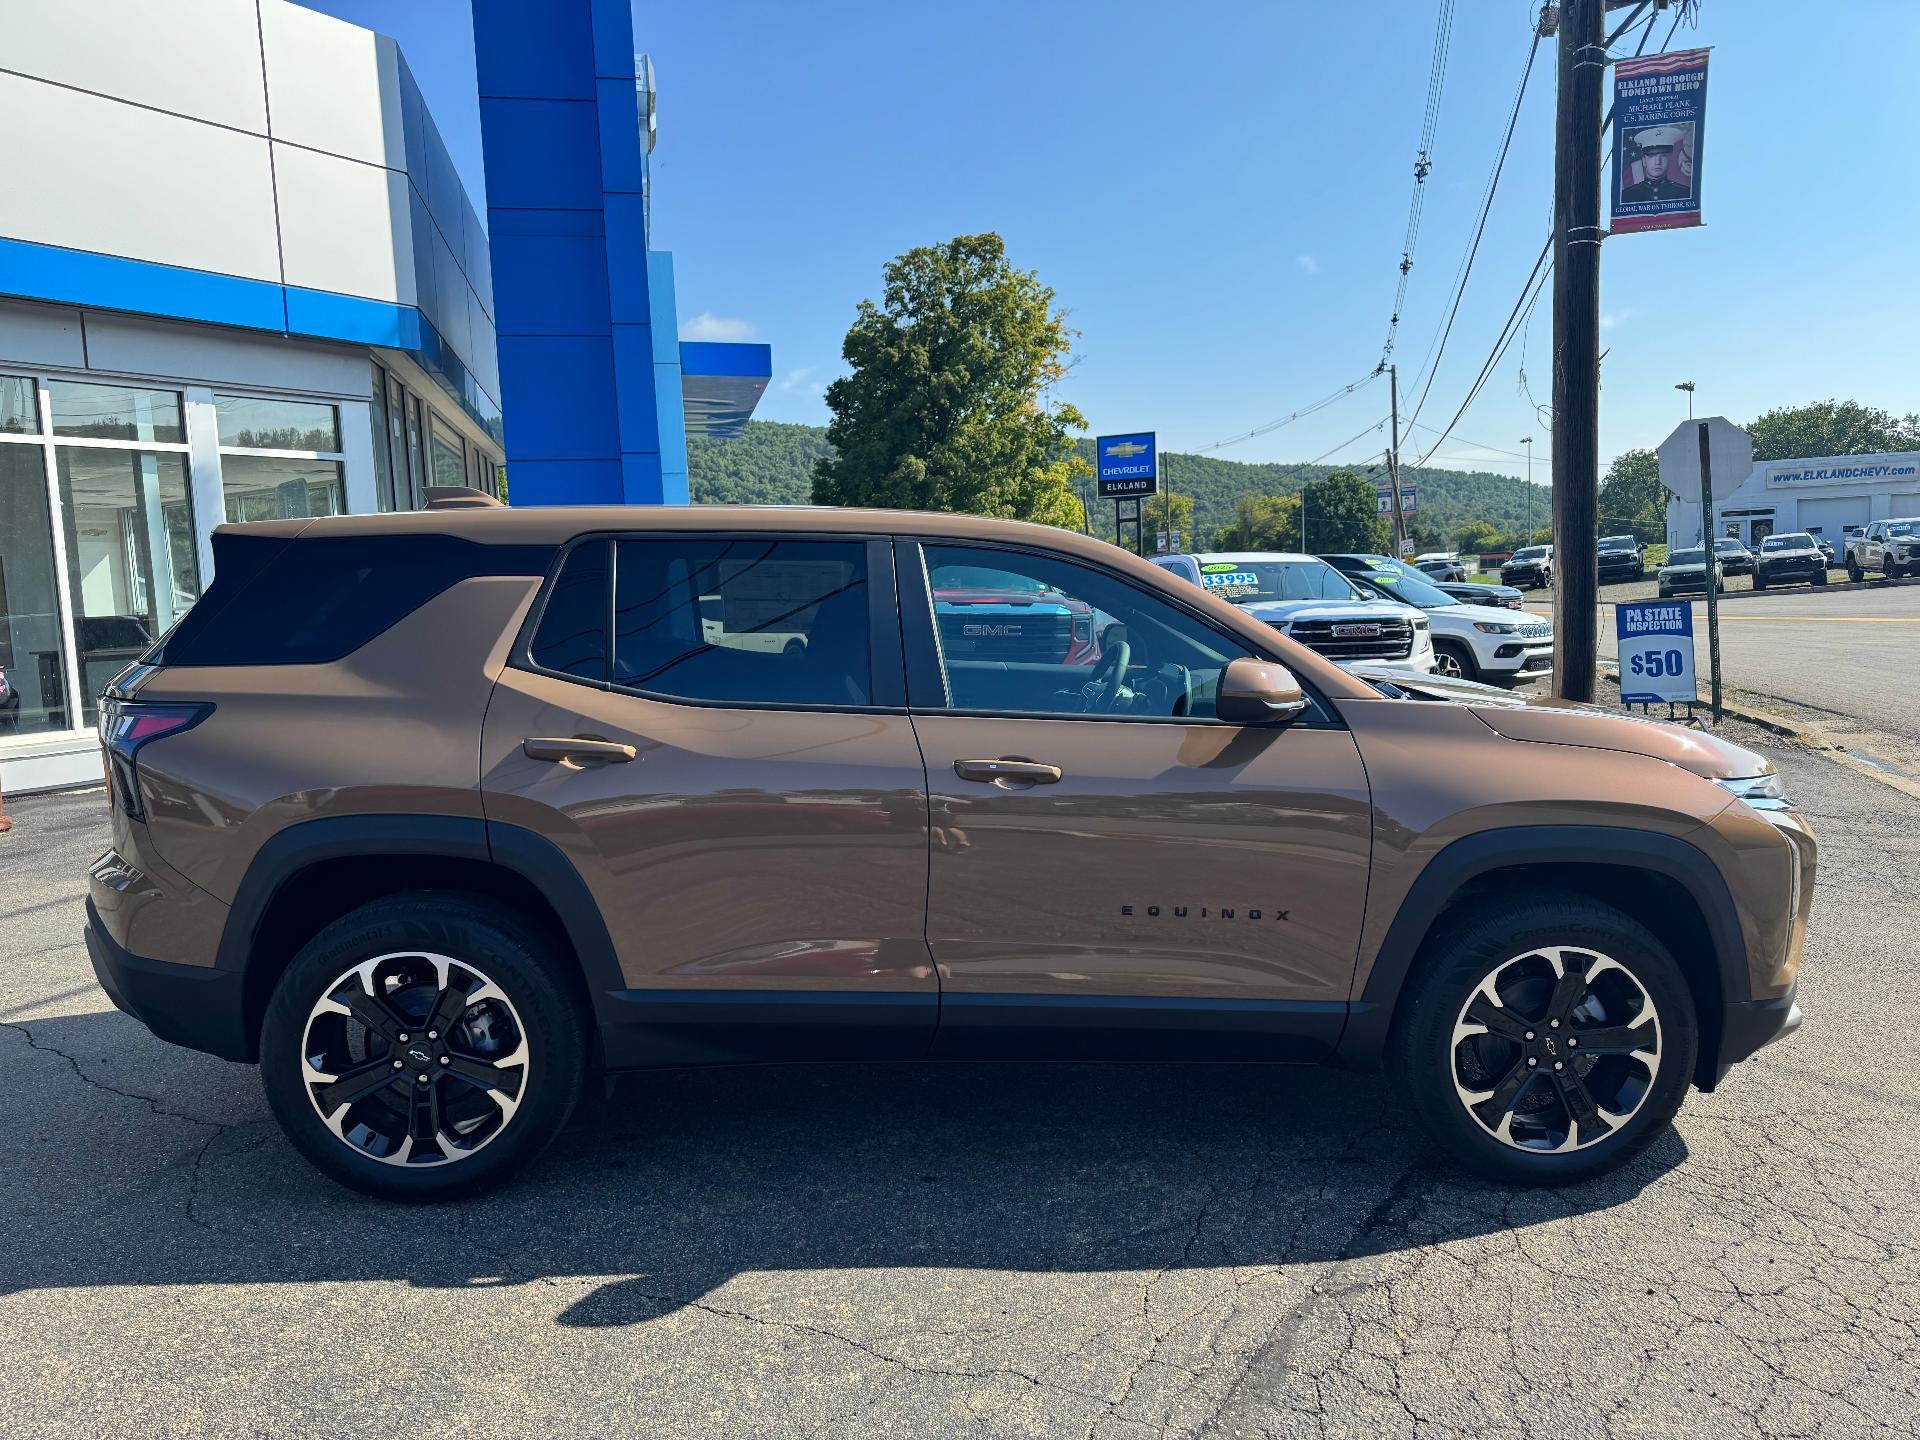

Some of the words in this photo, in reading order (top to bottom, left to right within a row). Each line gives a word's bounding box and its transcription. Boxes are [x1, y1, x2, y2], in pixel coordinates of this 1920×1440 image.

[1618, 78, 1656, 89] ELKLAND
[1660, 72, 1704, 84] BOROUGH
[1621, 84, 1672, 97] HOMETOWN
[1674, 81, 1700, 92] HERO
[1628, 103, 1664, 113] MICHAEL
[1665, 100, 1691, 109] PLANK
[1638, 112, 1669, 121] MARINE
[1670, 109, 1696, 118] CORPS
[1103, 465, 1150, 476] CHEVROLET
[1773, 466, 1916, 483] www.ELKLANDCHEVY.com
[1107, 481, 1147, 491] ELKLAND
[1203, 573, 1255, 586] 33995
[1626, 609, 1642, 622] PA
[1644, 607, 1682, 621] STATE
[963, 624, 1022, 637] GMC
[1336, 625, 1379, 636] GMC
[1626, 620, 1683, 632] INSPECTION
[1630, 649, 1684, 678] $50
[1121, 905, 1289, 921] EQUINOX
